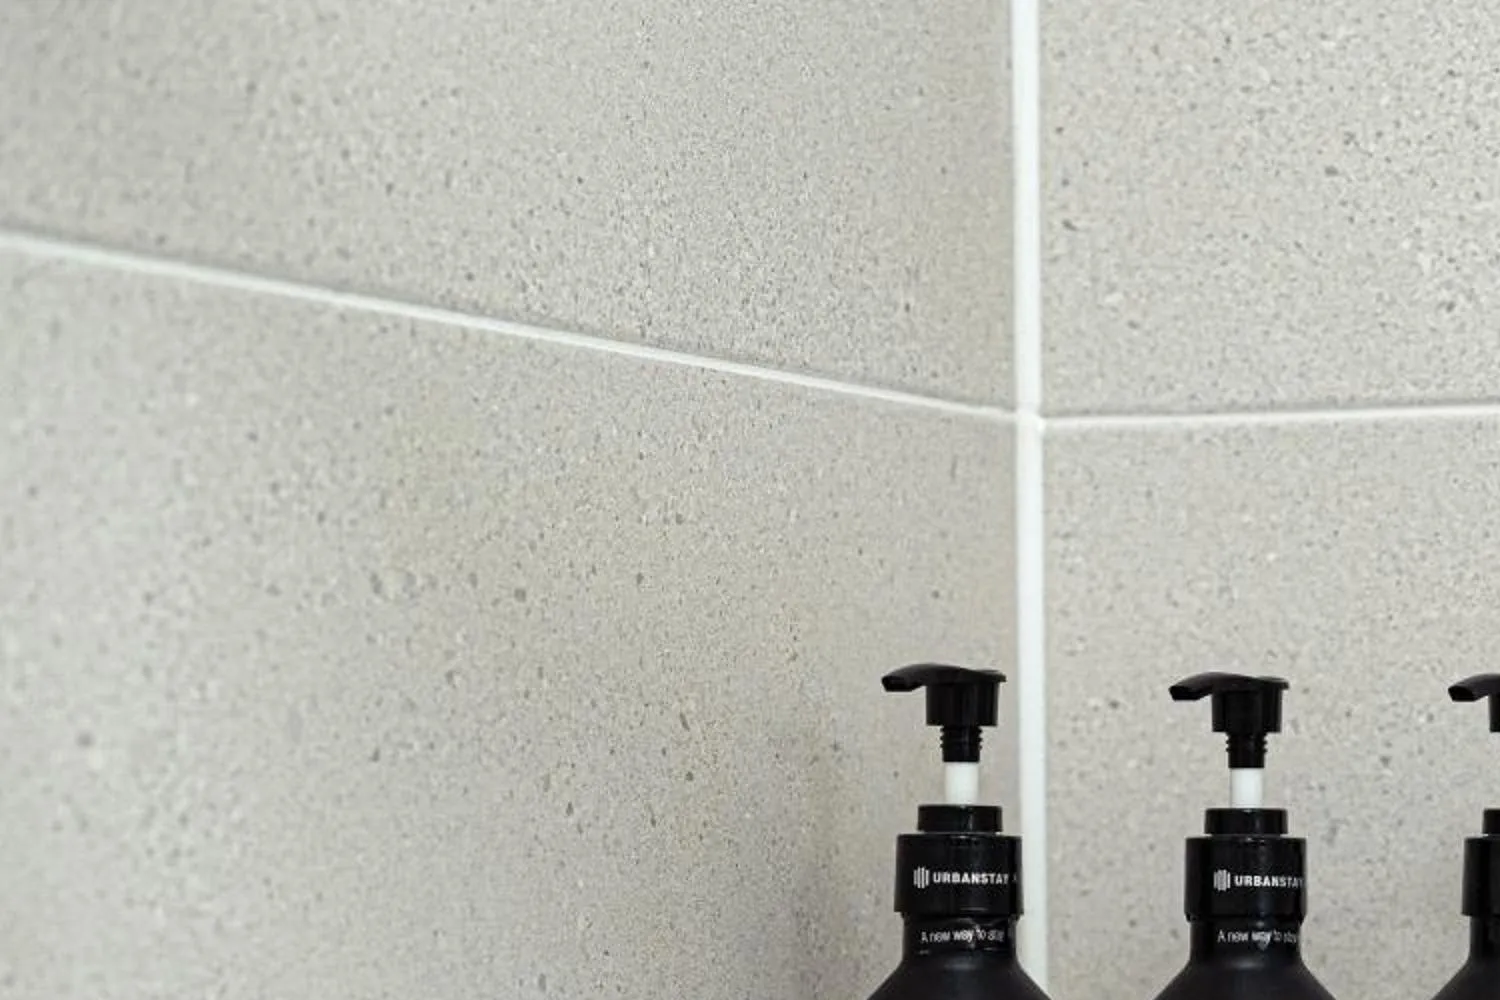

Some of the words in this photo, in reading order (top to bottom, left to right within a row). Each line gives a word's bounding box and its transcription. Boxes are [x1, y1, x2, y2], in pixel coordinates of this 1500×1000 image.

[929, 931, 950, 942] new
[1217, 929, 1226, 943] A
[1228, 931, 1248, 943] new
